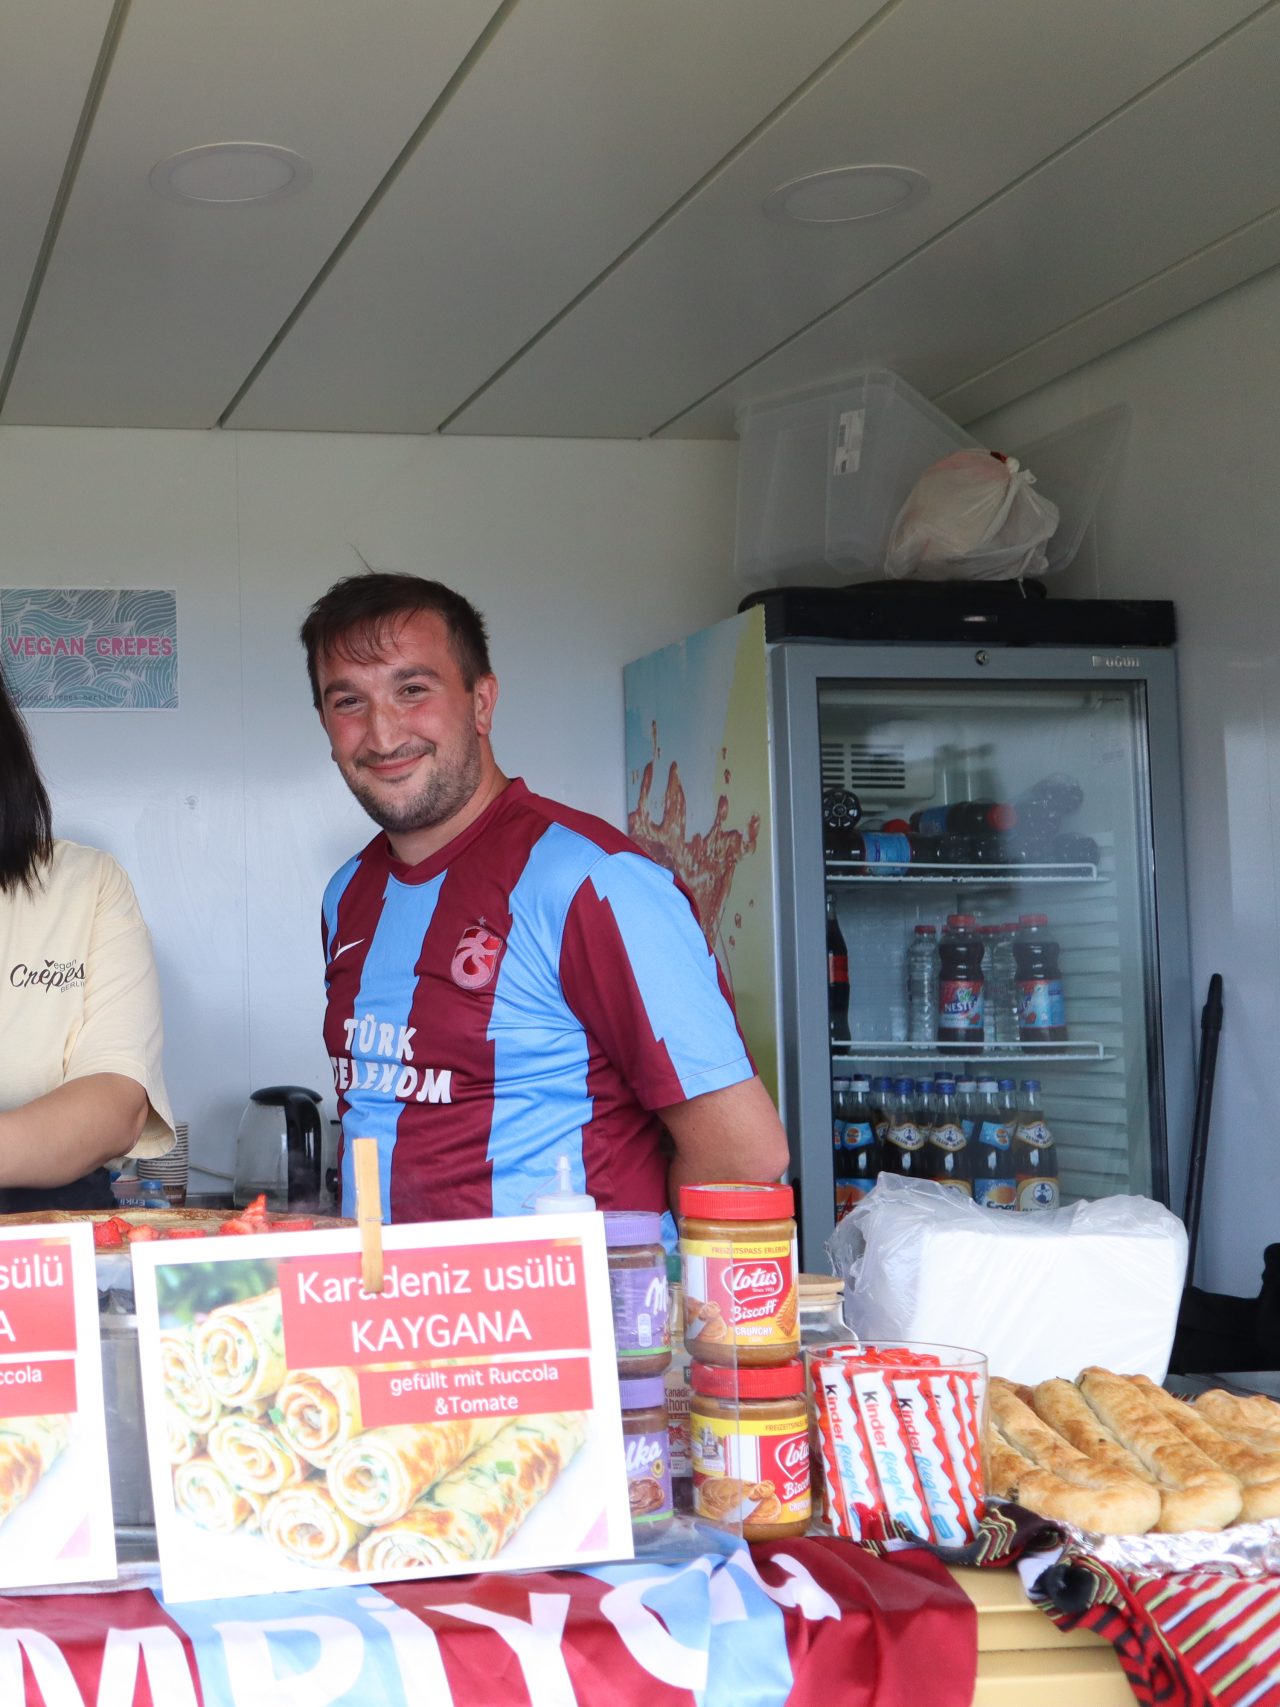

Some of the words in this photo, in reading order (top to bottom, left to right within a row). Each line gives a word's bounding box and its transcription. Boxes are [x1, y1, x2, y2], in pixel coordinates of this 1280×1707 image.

[7, 637, 85, 656] VEGAN
[96, 637, 173, 657] CREPES
[344, 1014, 417, 1062] TÜRK
[484, 1254, 577, 1292] usülü
[733, 1267, 777, 1291] Lotus
[729, 1299, 778, 1323] Biscoff
[351, 1309, 533, 1353] KAYGANA
[736, 1326, 773, 1336] CRUNCHY
[390, 1370, 448, 1396] gefüllt
[454, 1368, 484, 1388] mit
[490, 1364, 559, 1385] Ruccola
[434, 1395, 520, 1416] &Tomate
[825, 1384, 845, 1441] Kinder
[897, 1398, 923, 1453] Kinder
[627, 1436, 664, 1472] lka
[785, 1441, 810, 1468] Lotu
[862, 1391, 888, 1448] Kinder
[876, 1451, 914, 1506] Riegel
